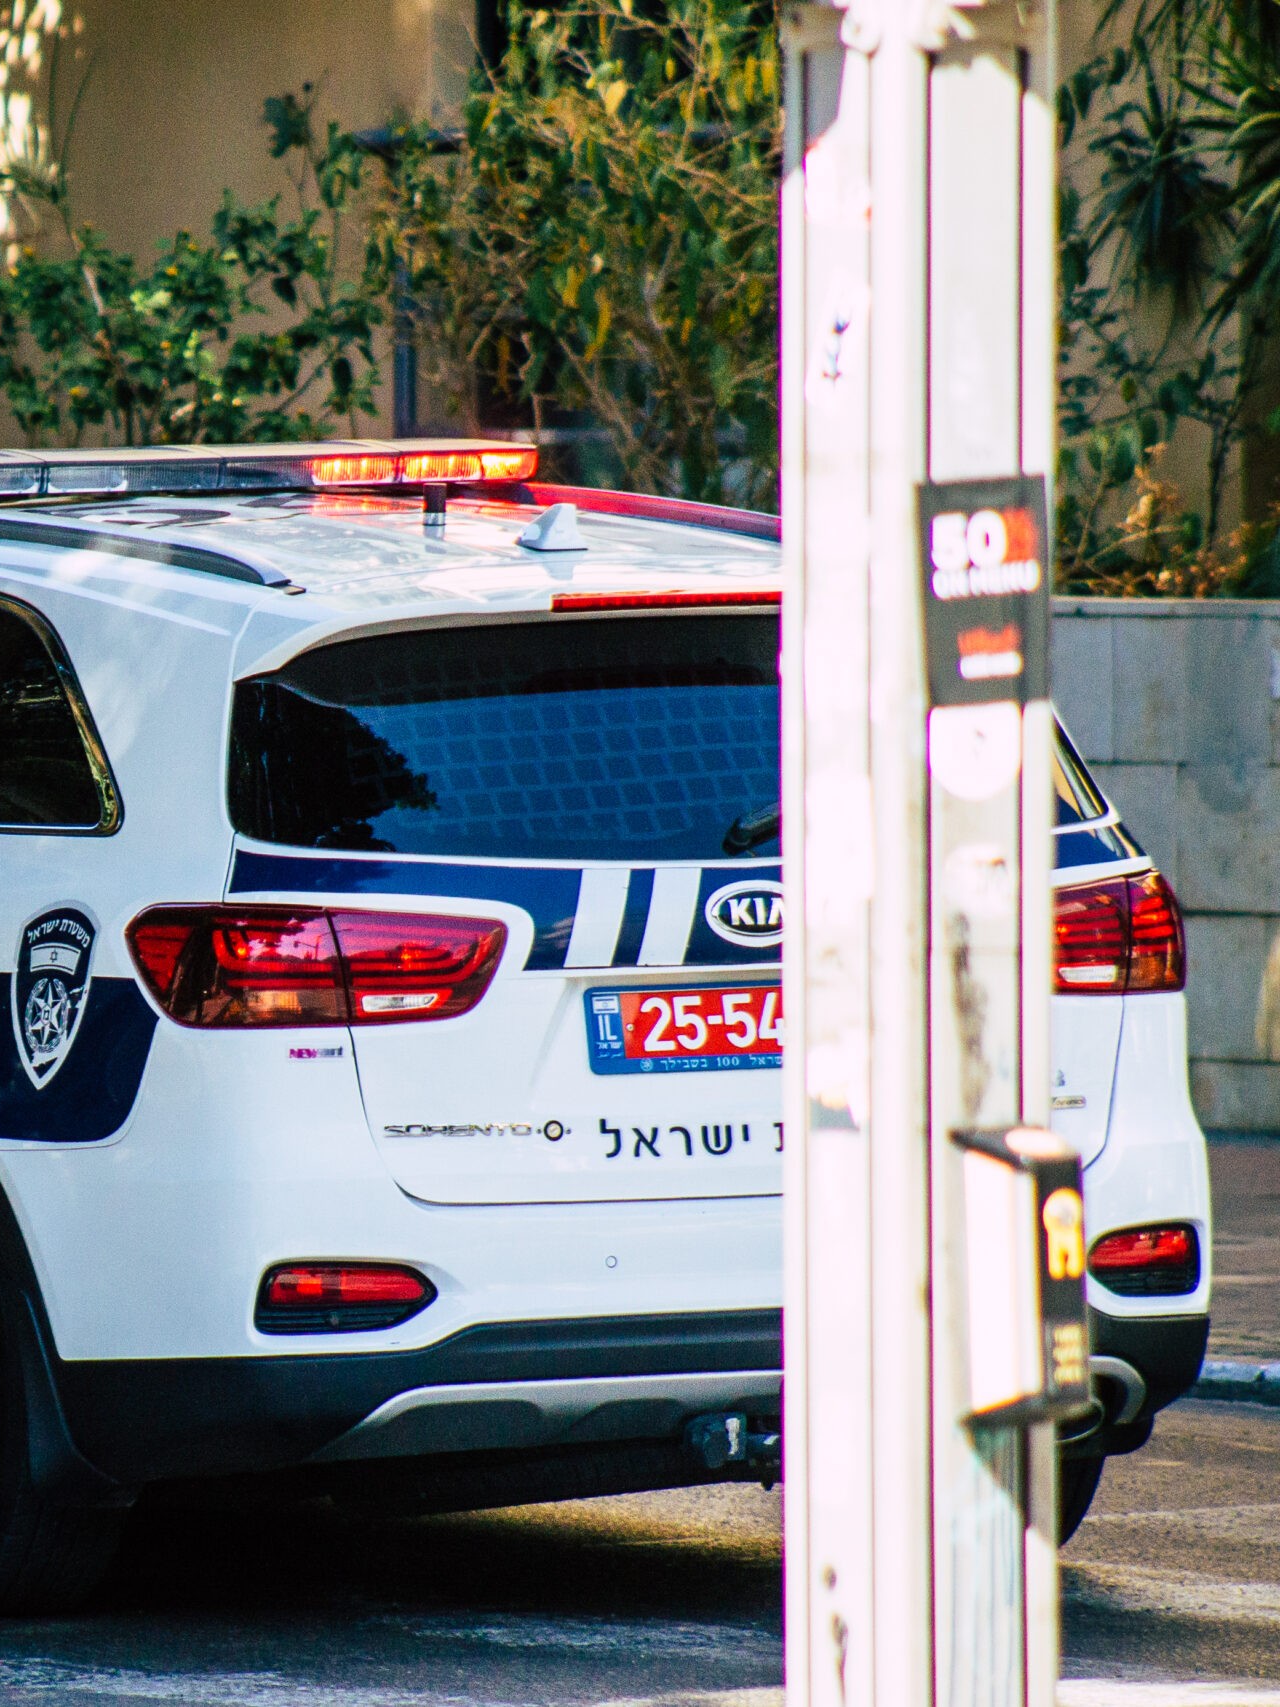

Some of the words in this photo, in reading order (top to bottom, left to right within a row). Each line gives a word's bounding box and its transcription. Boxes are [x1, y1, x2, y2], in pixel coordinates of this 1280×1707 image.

[727, 897, 784, 926] KIA
[27, 919, 60, 944] ישראל
[59, 918, 91, 948] משטרת
[597, 1014, 618, 1041] IL
[639, 991, 784, 1052] 25-54
[660, 1057, 708, 1071] בשבילך
[716, 1056, 740, 1068] 100
[599, 1117, 750, 1159] ישראל
